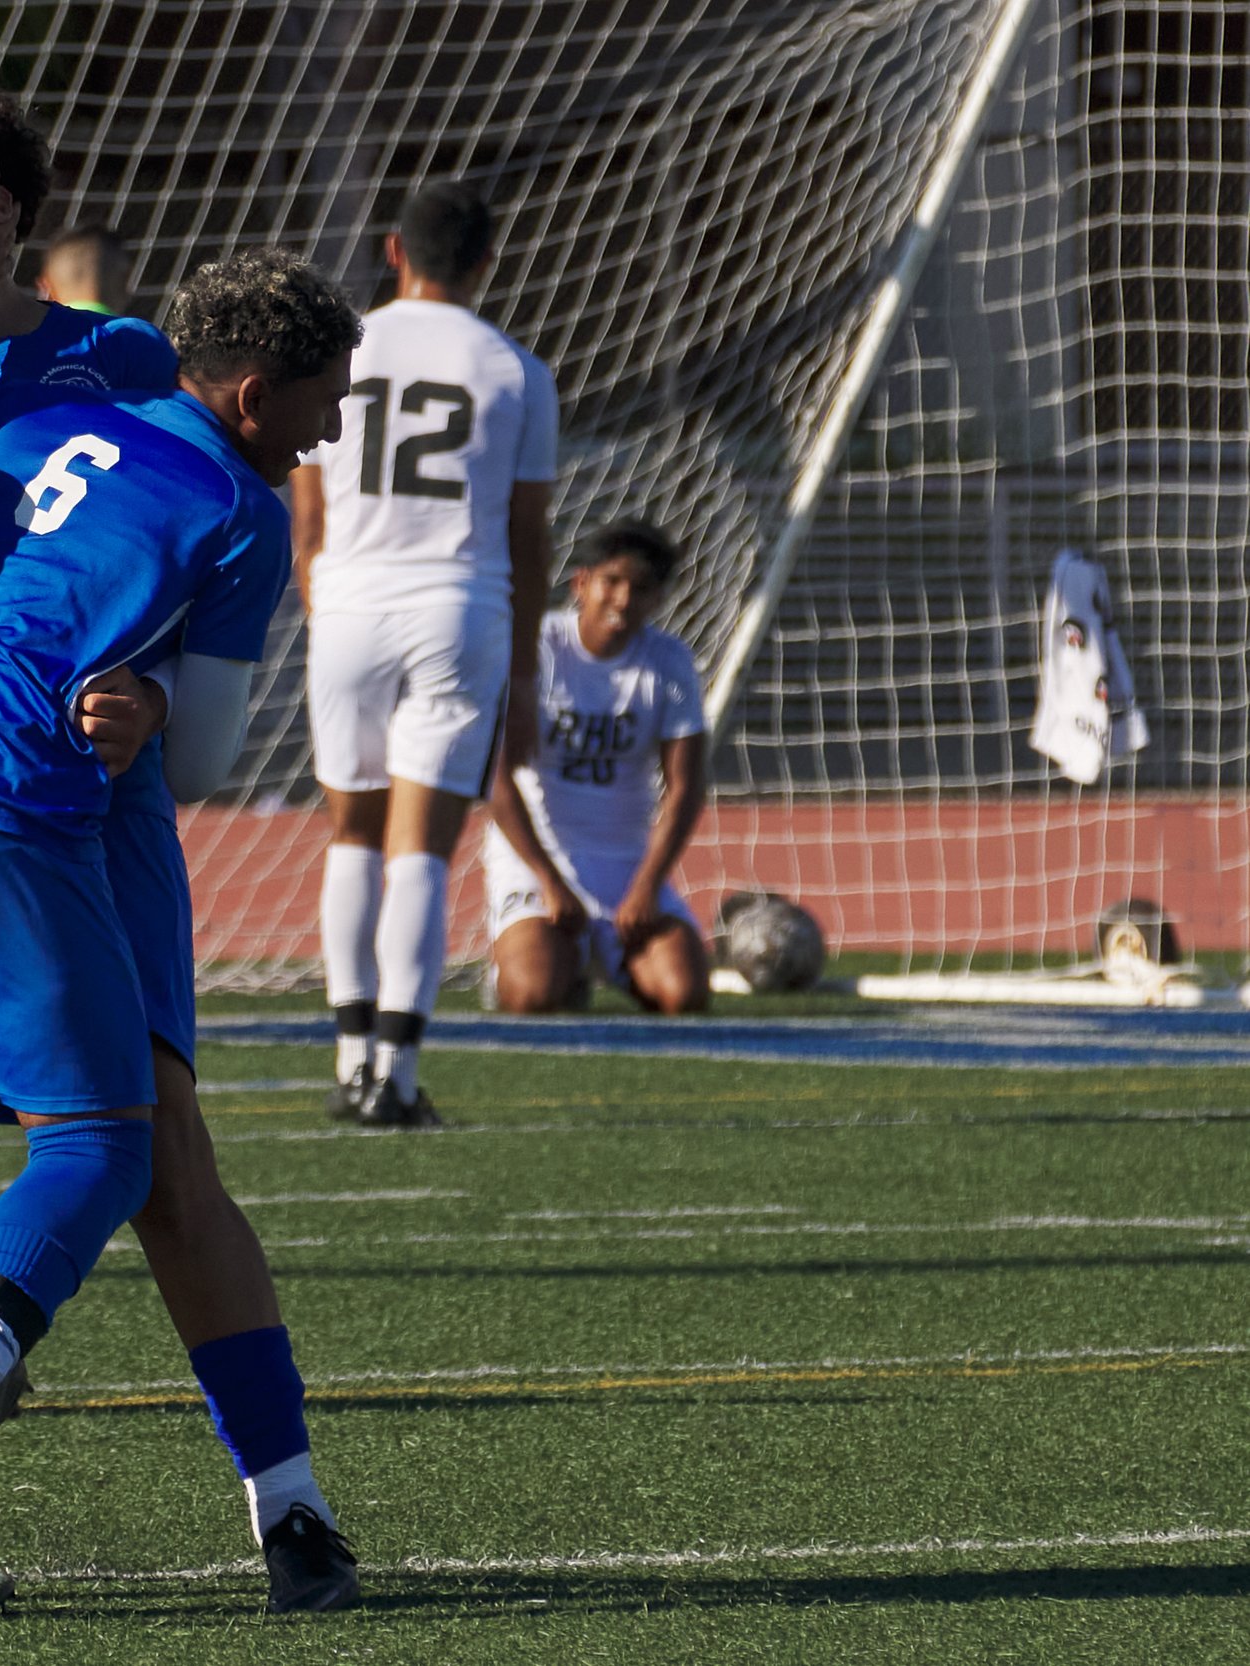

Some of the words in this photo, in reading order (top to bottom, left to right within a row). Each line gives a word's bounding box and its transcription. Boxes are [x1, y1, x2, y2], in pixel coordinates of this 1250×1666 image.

[15, 433, 120, 535] 6
[350, 377, 473, 499] 12
[548, 709, 637, 756] RHC
